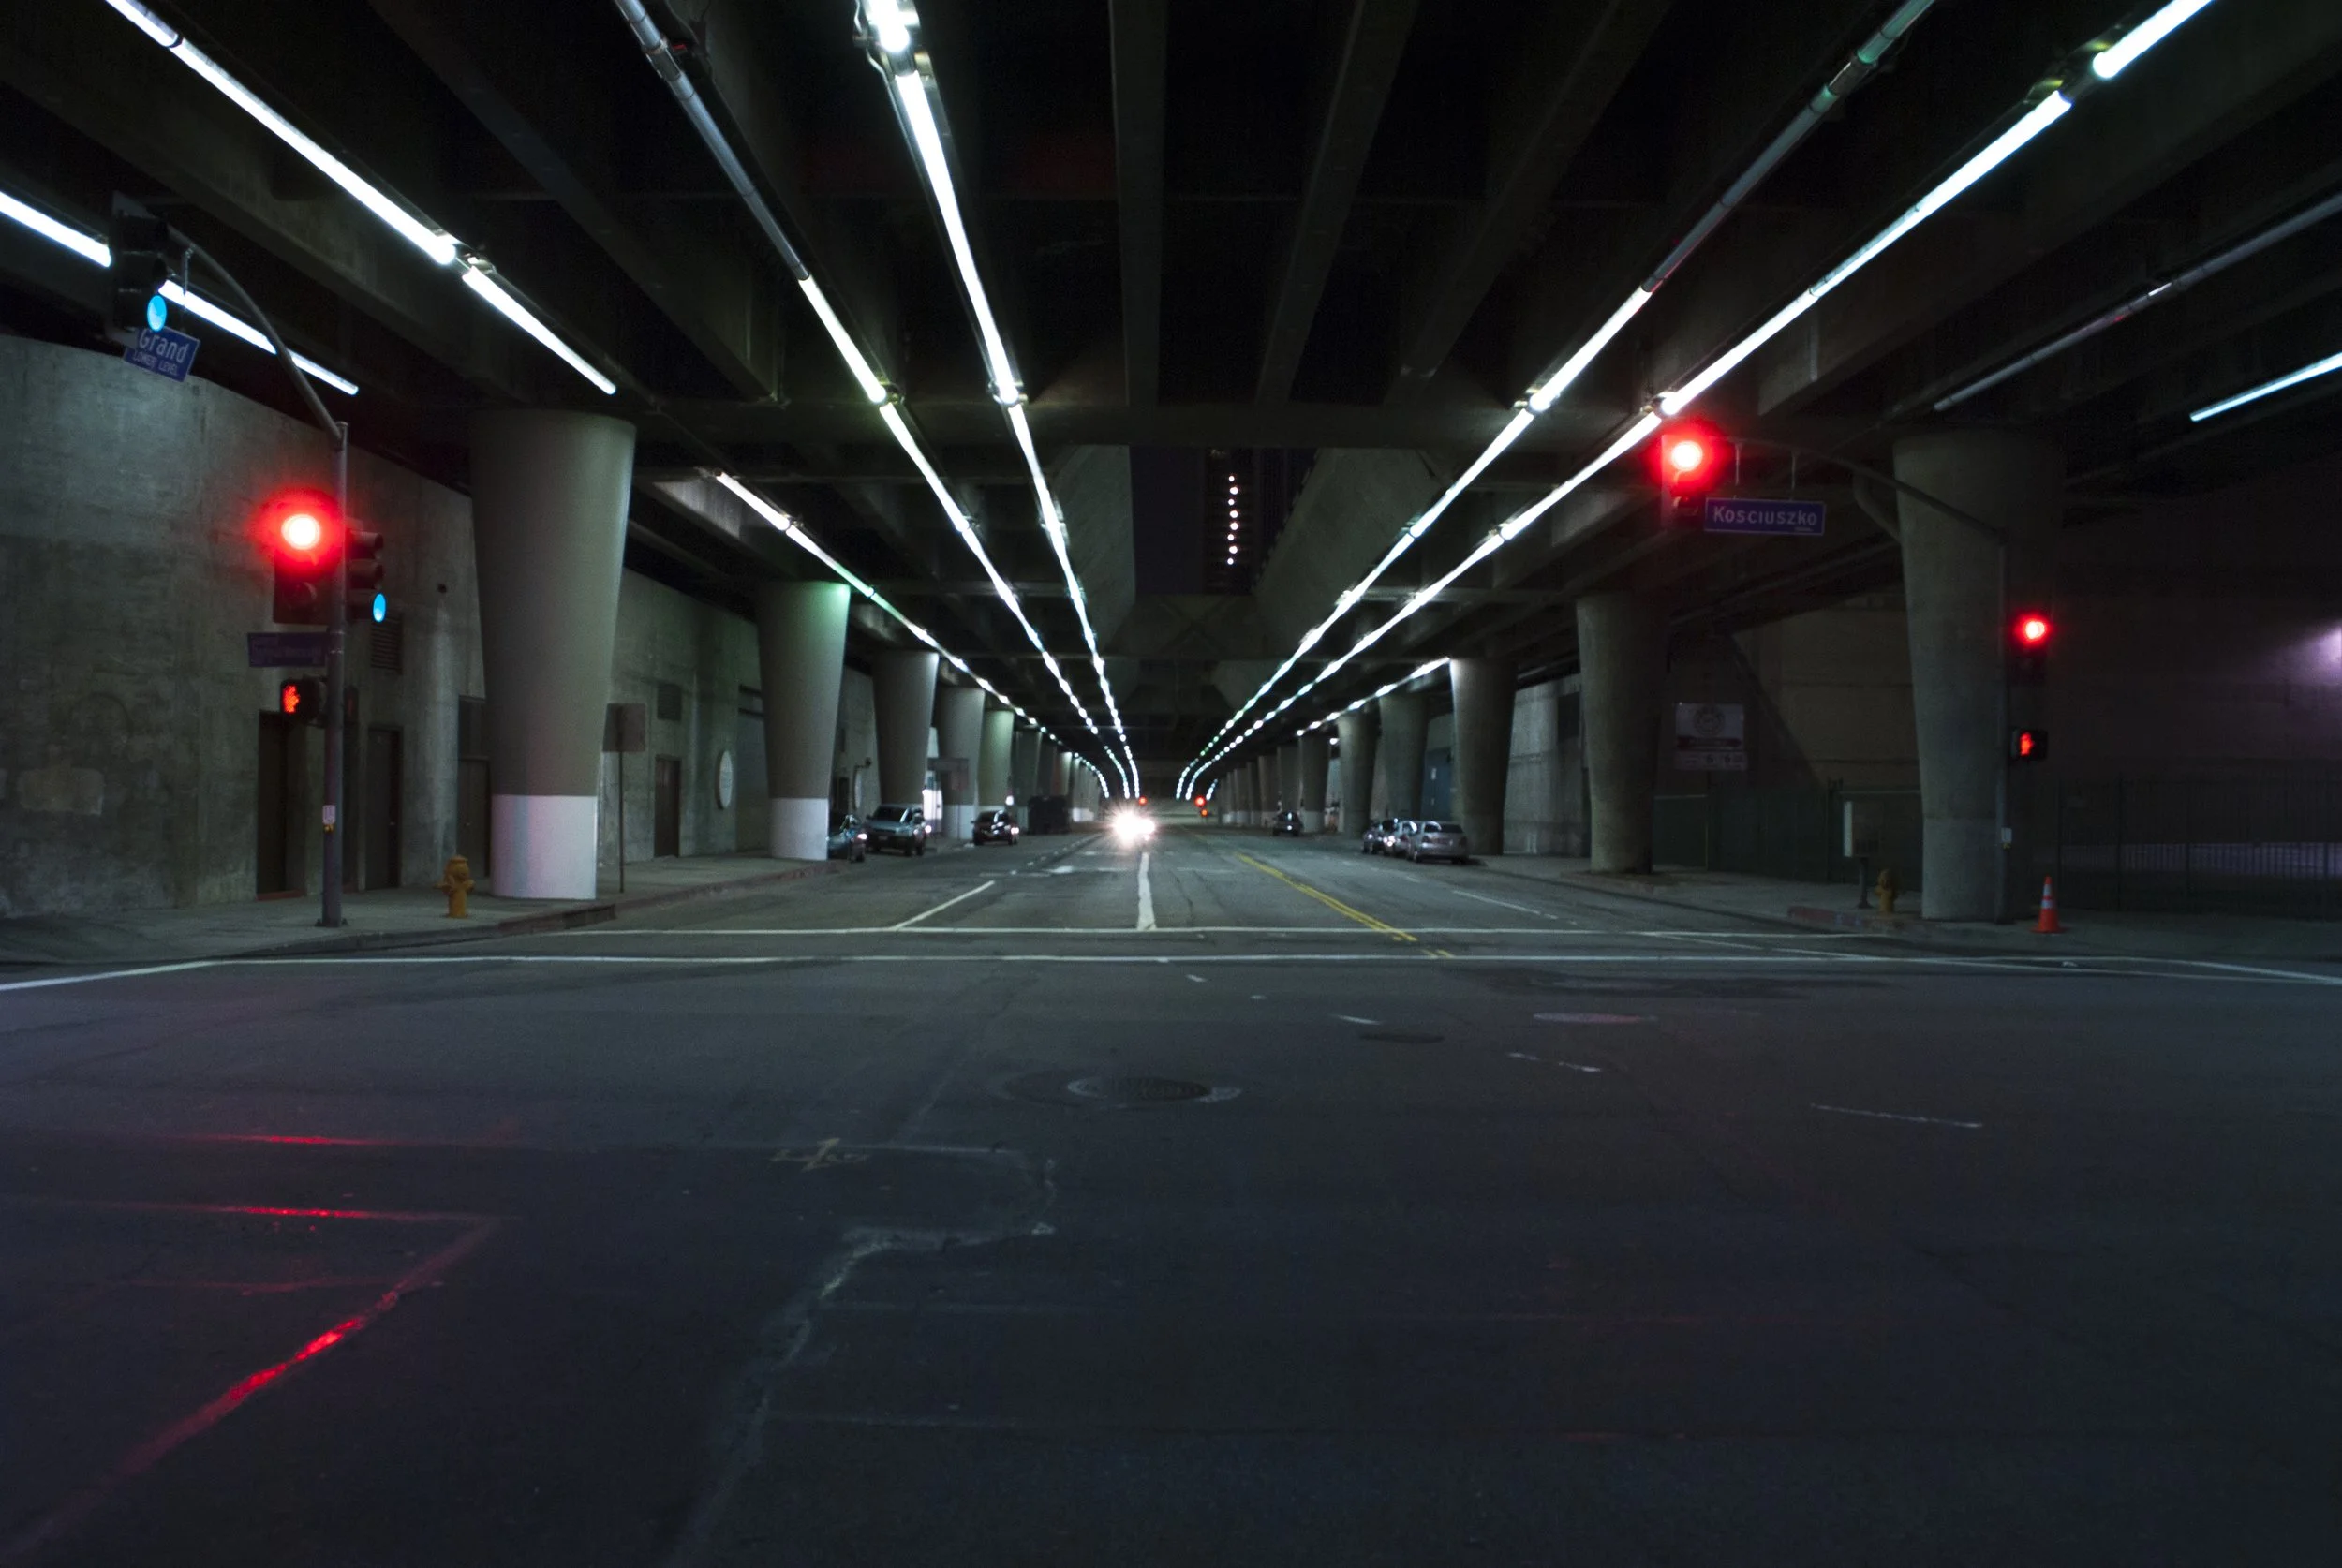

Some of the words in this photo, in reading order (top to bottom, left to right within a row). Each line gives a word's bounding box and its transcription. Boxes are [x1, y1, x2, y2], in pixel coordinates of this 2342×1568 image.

[139, 328, 190, 364] Grand
[158, 360, 179, 377] LEVEL
[1712, 505, 1817, 525] Kosciuszko
